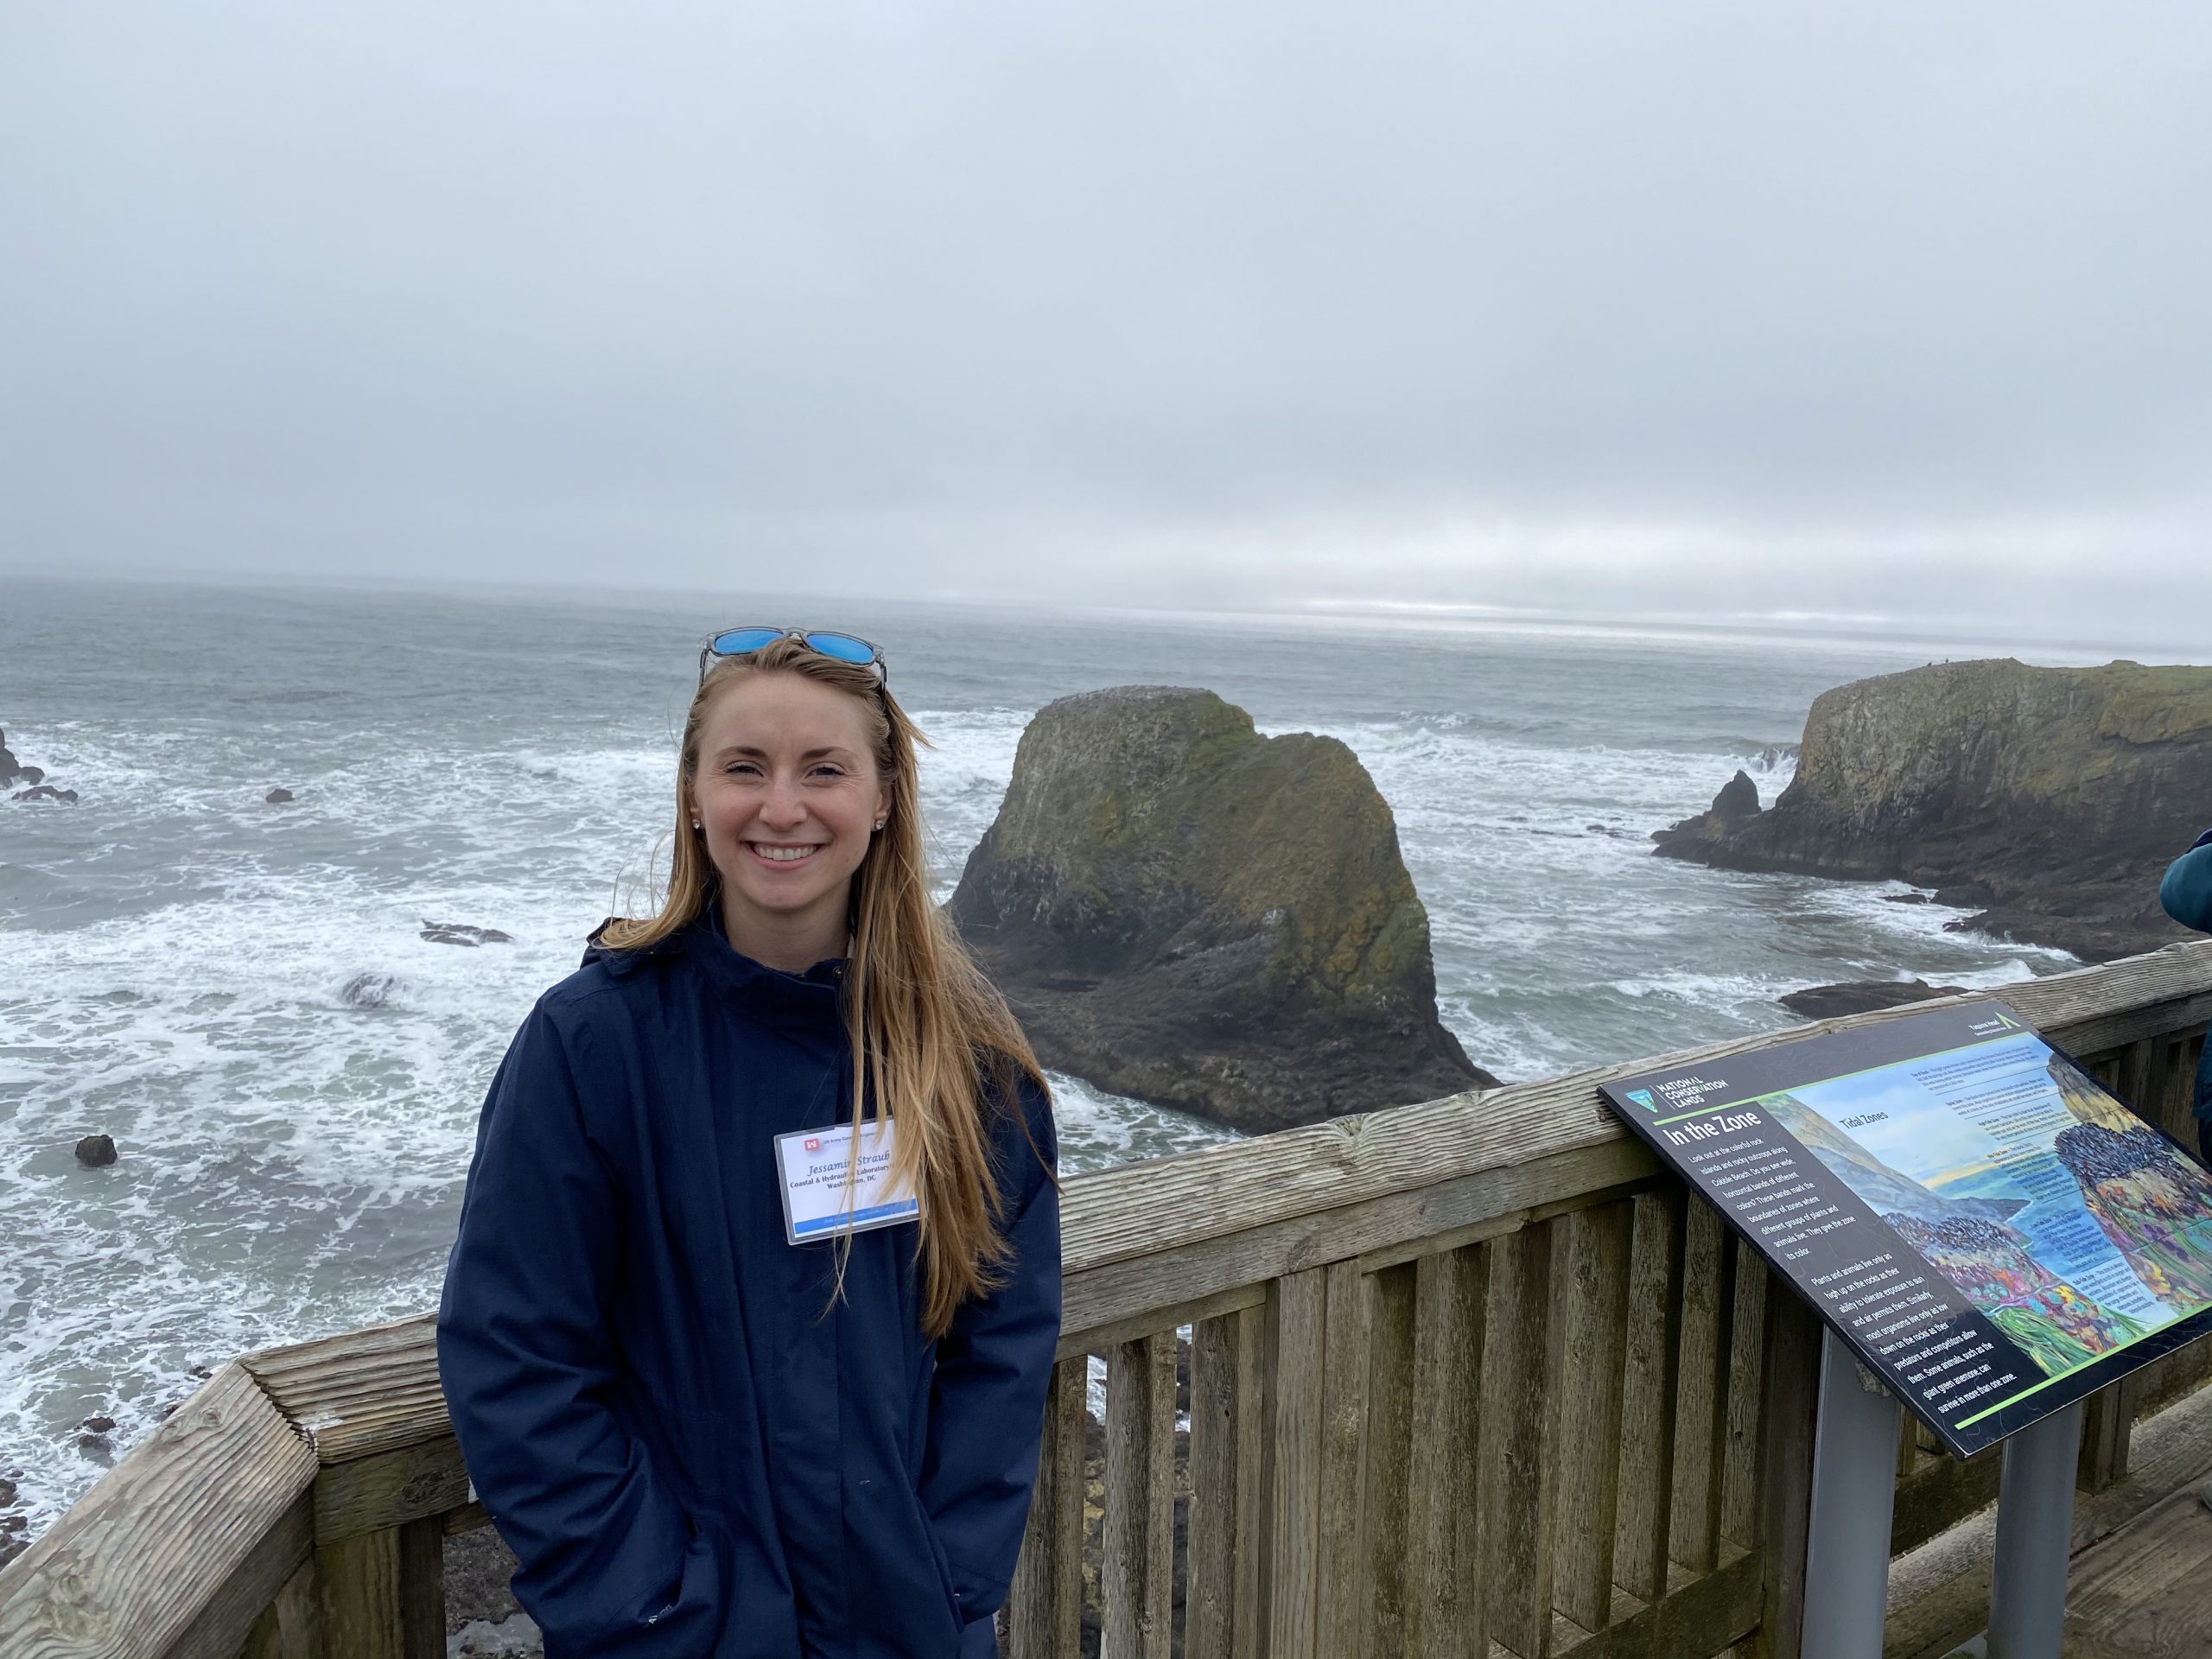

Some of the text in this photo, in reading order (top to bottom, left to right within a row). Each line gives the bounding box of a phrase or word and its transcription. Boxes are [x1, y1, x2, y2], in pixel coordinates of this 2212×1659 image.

[1657, 1077, 1703, 1091] NATIONAL
[1666, 1080, 1727, 1099] CONSERVATION
[1673, 1095, 1704, 1108] LANDS
[1662, 1113, 1761, 1145] In the Zone
[1840, 1112, 1888, 1128] Tidal Zones
[857, 1149, 891, 1166] Straub
[1688, 1154, 1705, 1163] Look
[1730, 1141, 1751, 1151] colorful
[1700, 1165, 1722, 1174] islands
[1748, 1151, 1772, 1160] outcrops
[790, 1178, 814, 1189] Coastal
[856, 1165, 890, 1176] Laboratory
[1712, 1177, 1733, 1186] Cobble
[1731, 1171, 1752, 1180] Beach.
[1723, 1185, 1752, 1198] horizontal
[1750, 1180, 1770, 1190] bands
[1776, 1172, 1799, 1183] different
[1737, 1199, 1756, 1210] colors?
[1755, 1195, 1775, 1204] These
[1772, 1190, 1792, 1198] bands
[1790, 1185, 1805, 1193] mark
[1747, 1209, 1780, 1222] boundaries
[1785, 1202, 1803, 1211] zones
[1762, 1223, 1786, 1235] different
[1785, 1217, 1805, 1229] groups
[1810, 1210, 1828, 1220] plants
[1827, 1205, 1839, 1213] and
[1774, 1236, 1797, 1247] animals
[1821, 1224, 1834, 1233] give
[1795, 1249, 1809, 1257] color.
[1811, 1275, 1832, 1286] Plants
[1830, 1270, 1843, 1279] and
[1841, 1263, 1864, 1275] animals
[1872, 1255, 1885, 1264] only
[1824, 1289, 1840, 1299] high
[1864, 1275, 1880, 1285] rocks
[1840, 1302, 1859, 1313] ability
[1861, 1292, 1885, 1303] tolerate
[1884, 1283, 1909, 1295] exposure
[1853, 1316, 1866, 1326] and
[1872, 1307, 1894, 1320] permits
[1891, 1301, 1910, 1311] them.
[1907, 1292, 1934, 1304] Similarly,
[1866, 1330, 1883, 1340] most
[1881, 1319, 1910, 1334] organisms
[1919, 1310, 1933, 1319] only
[1880, 1344, 1897, 1355] down
[1913, 1331, 1929, 1341] rocks
[1934, 1323, 1948, 1332] their
[1894, 1330, 1977, 1370] predators and competitors allow
[1908, 1373, 1927, 1383] them.
[1923, 1365, 1943, 1376] Some
[1941, 1356, 1966, 1369] animals,
[1962, 1349, 1978, 1359] such
[1923, 1364, 1991, 1400] giant green anemone, can
[1938, 1400, 1960, 1413] survive
[1963, 1390, 1980, 1401] more
[1977, 1384, 1993, 1394] than
[2000, 1374, 2017, 1383] zone.
